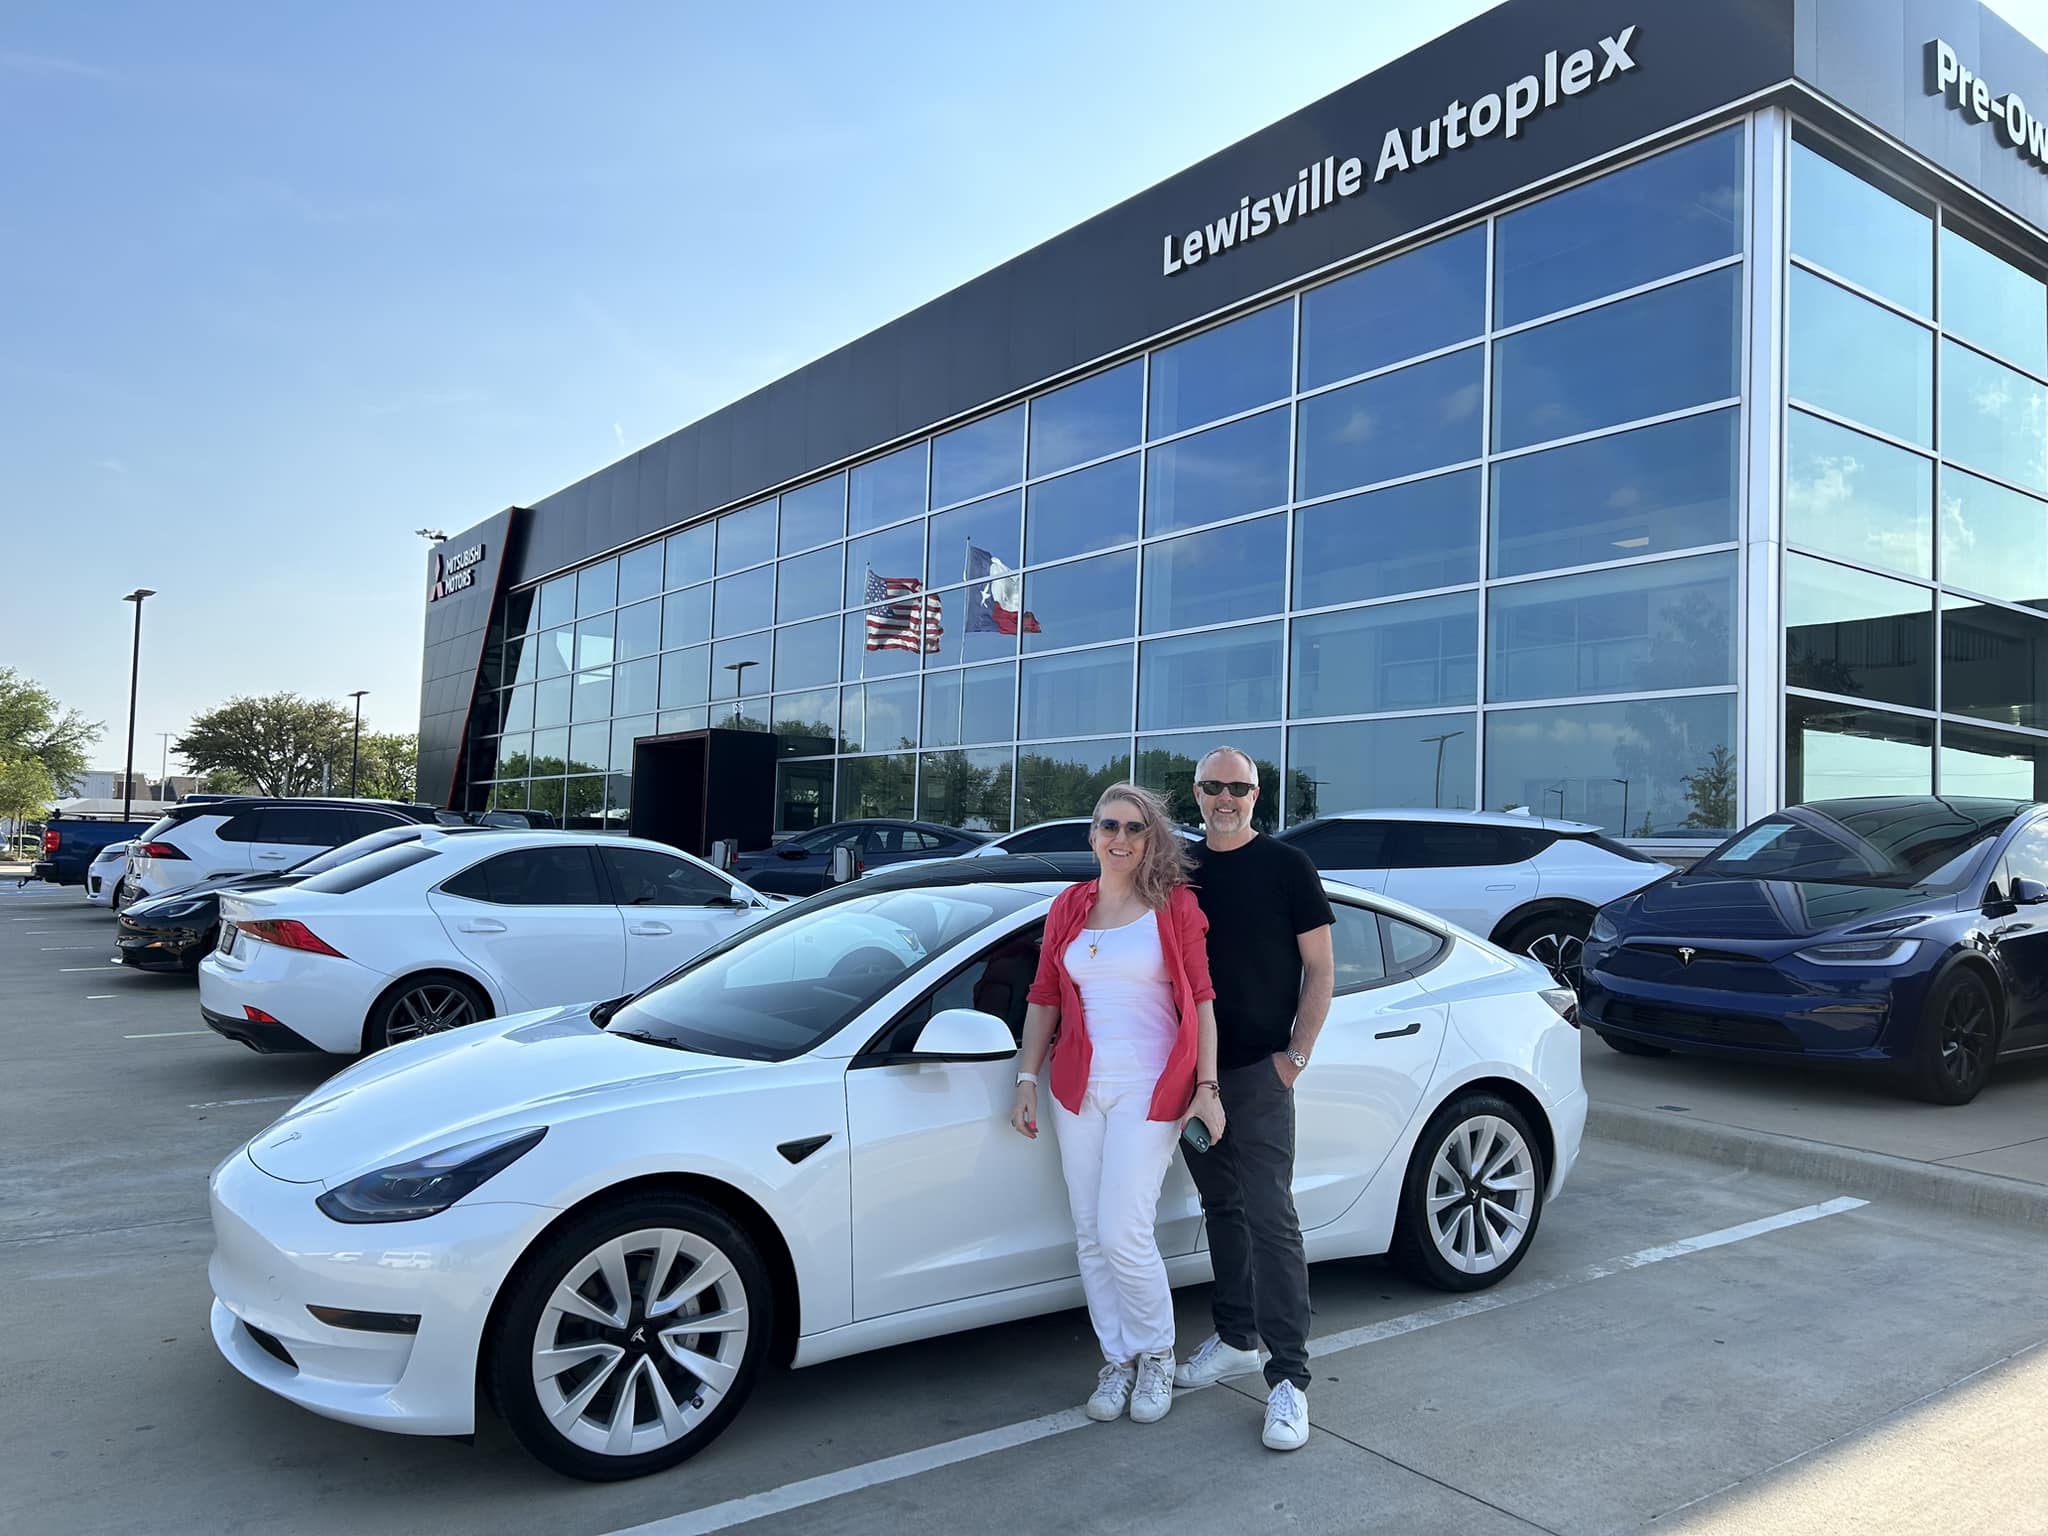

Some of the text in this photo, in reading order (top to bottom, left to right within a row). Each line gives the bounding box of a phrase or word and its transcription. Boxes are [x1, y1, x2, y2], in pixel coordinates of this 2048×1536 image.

[1163, 24, 1636, 276] Lewisville Autoplex
[444, 569, 472, 595] MOTORS
